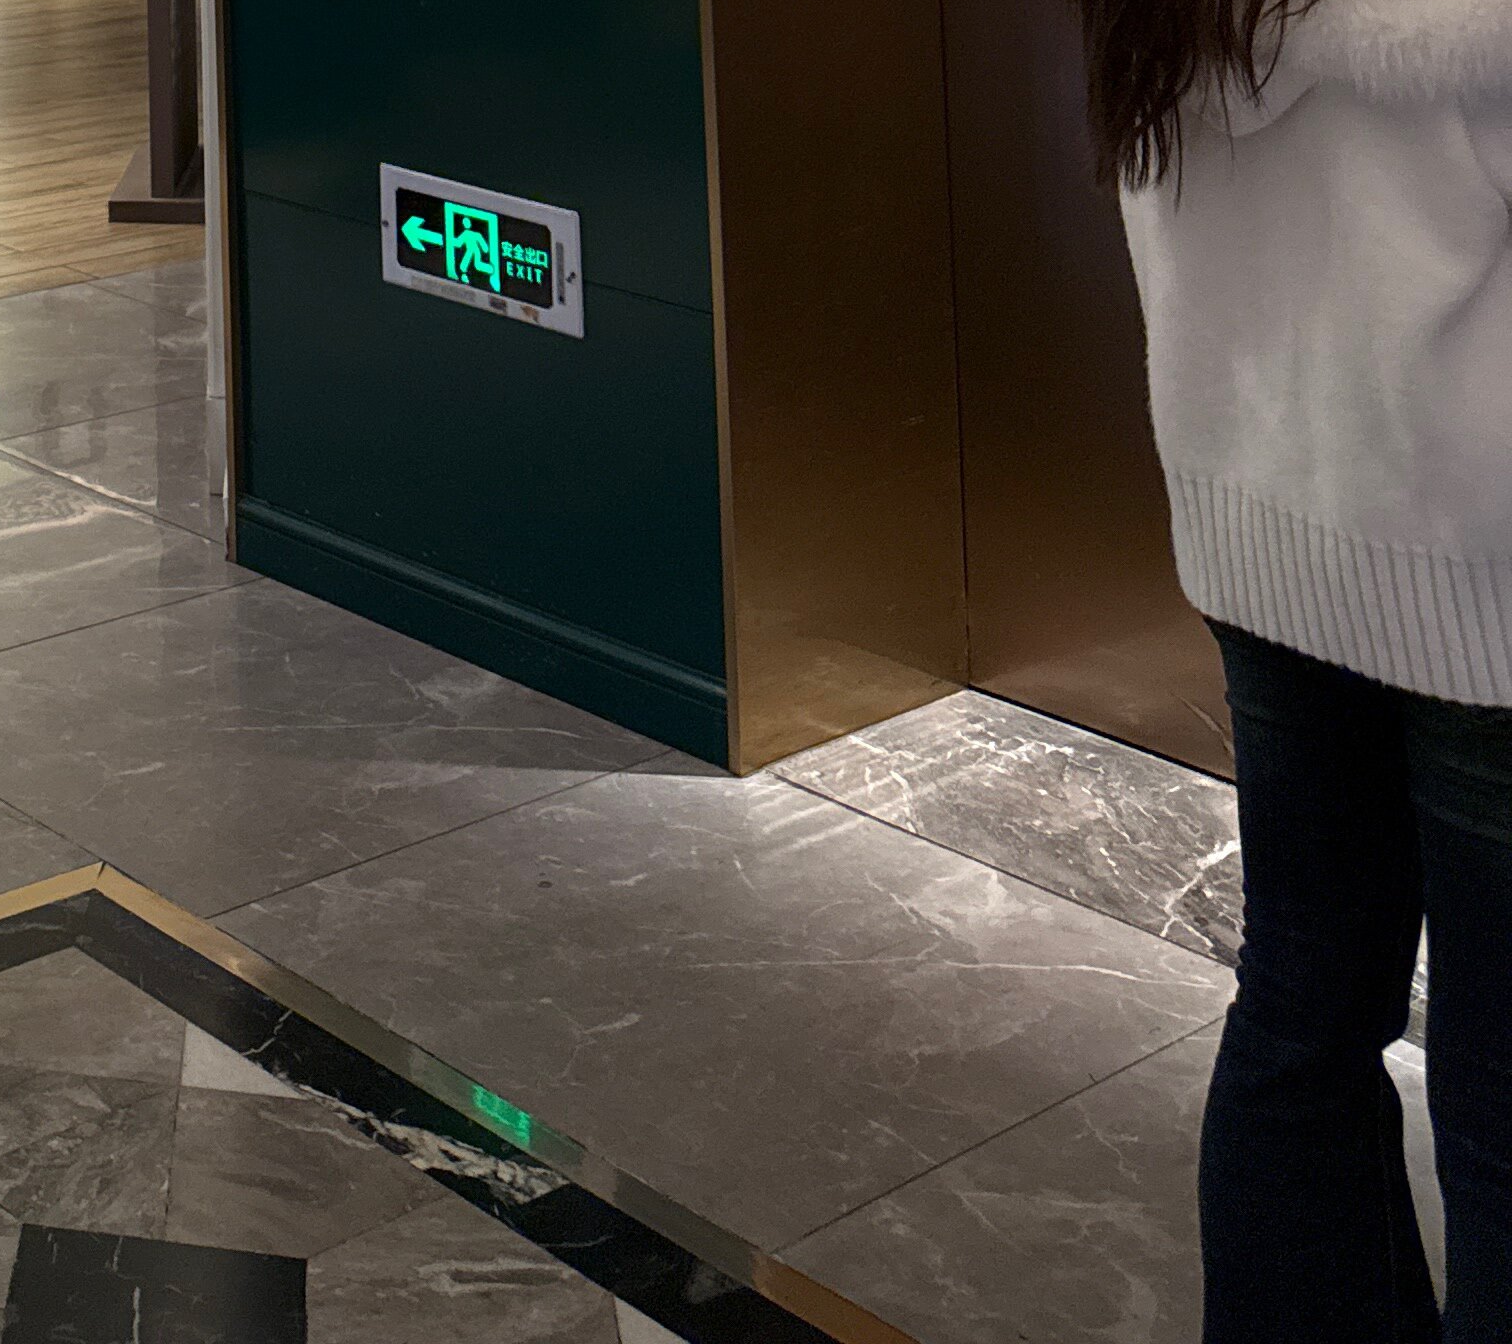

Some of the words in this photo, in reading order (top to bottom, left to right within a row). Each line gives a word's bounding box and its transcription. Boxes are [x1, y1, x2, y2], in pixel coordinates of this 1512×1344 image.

[501, 241, 548, 268] 安全出口
[506, 261, 543, 285] EXIT
